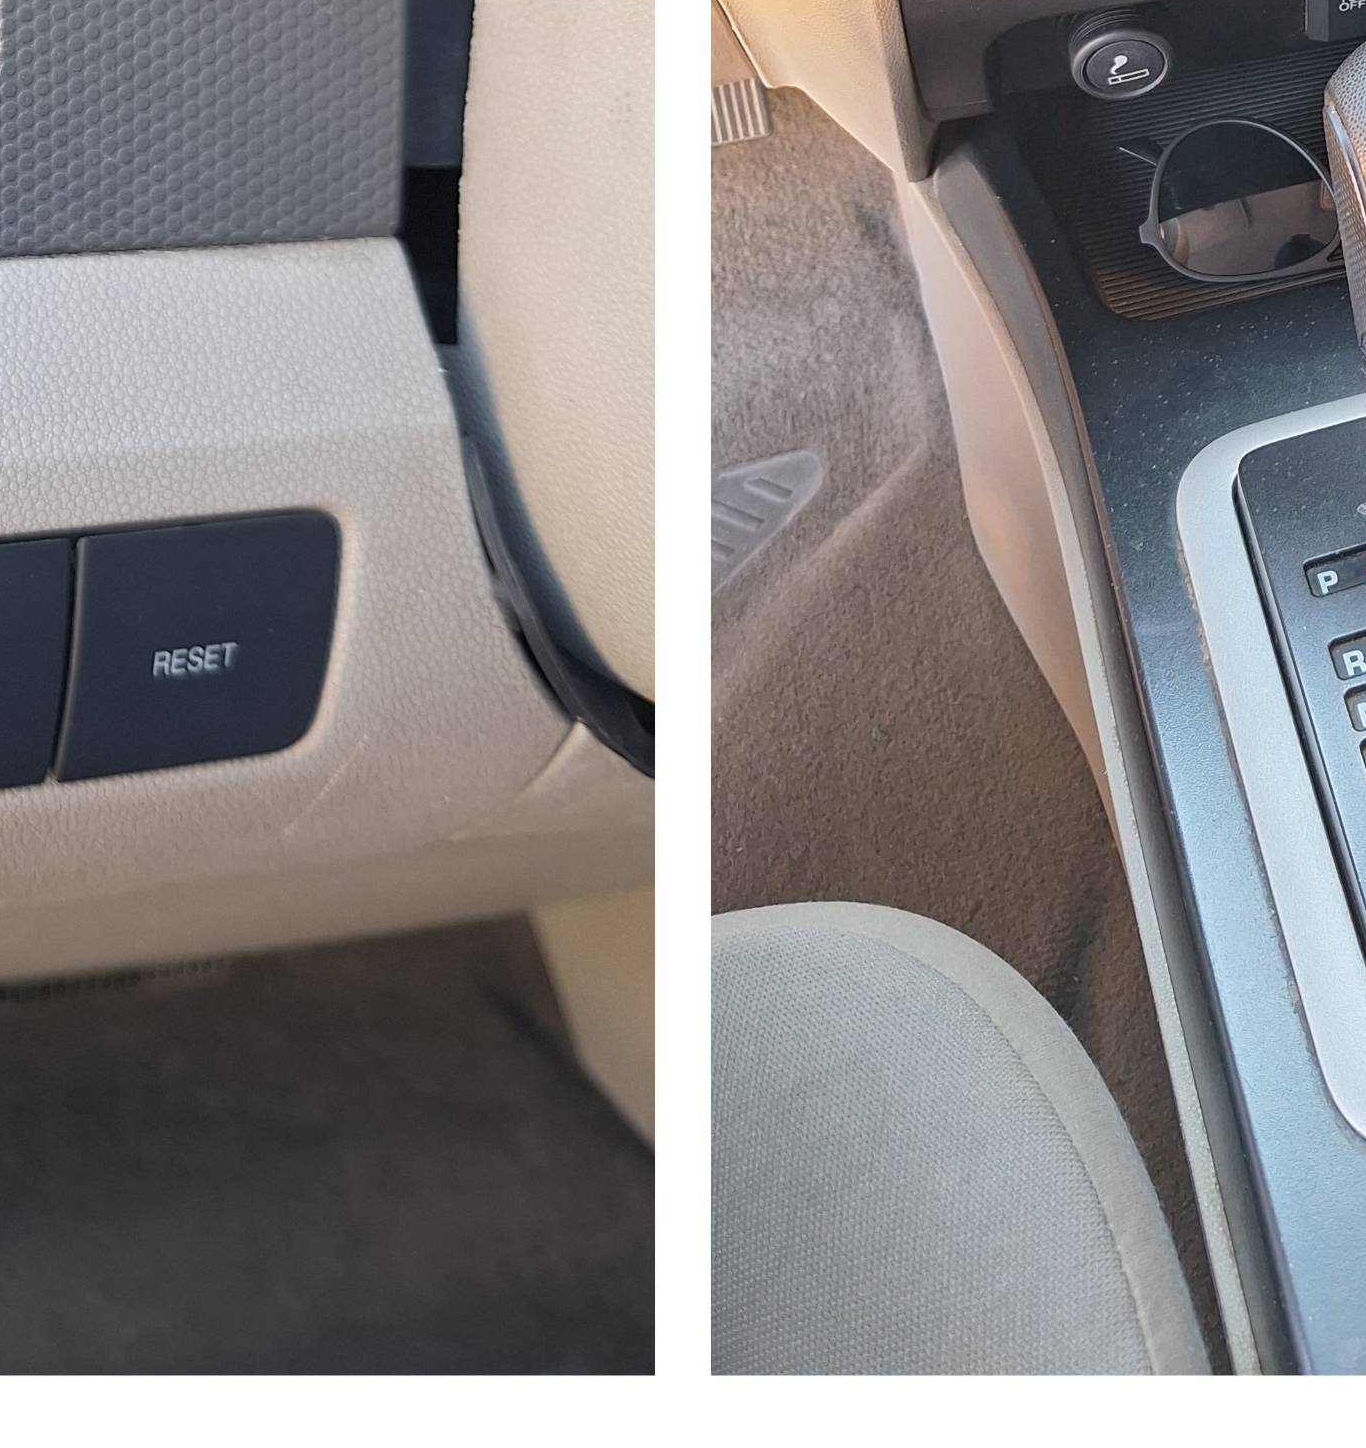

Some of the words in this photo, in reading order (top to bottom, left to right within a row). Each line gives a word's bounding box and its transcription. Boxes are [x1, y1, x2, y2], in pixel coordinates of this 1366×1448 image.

[1339, 0, 1366, 12] OFF
[1317, 569, 1338, 595] P
[152, 641, 238, 679] RESET
